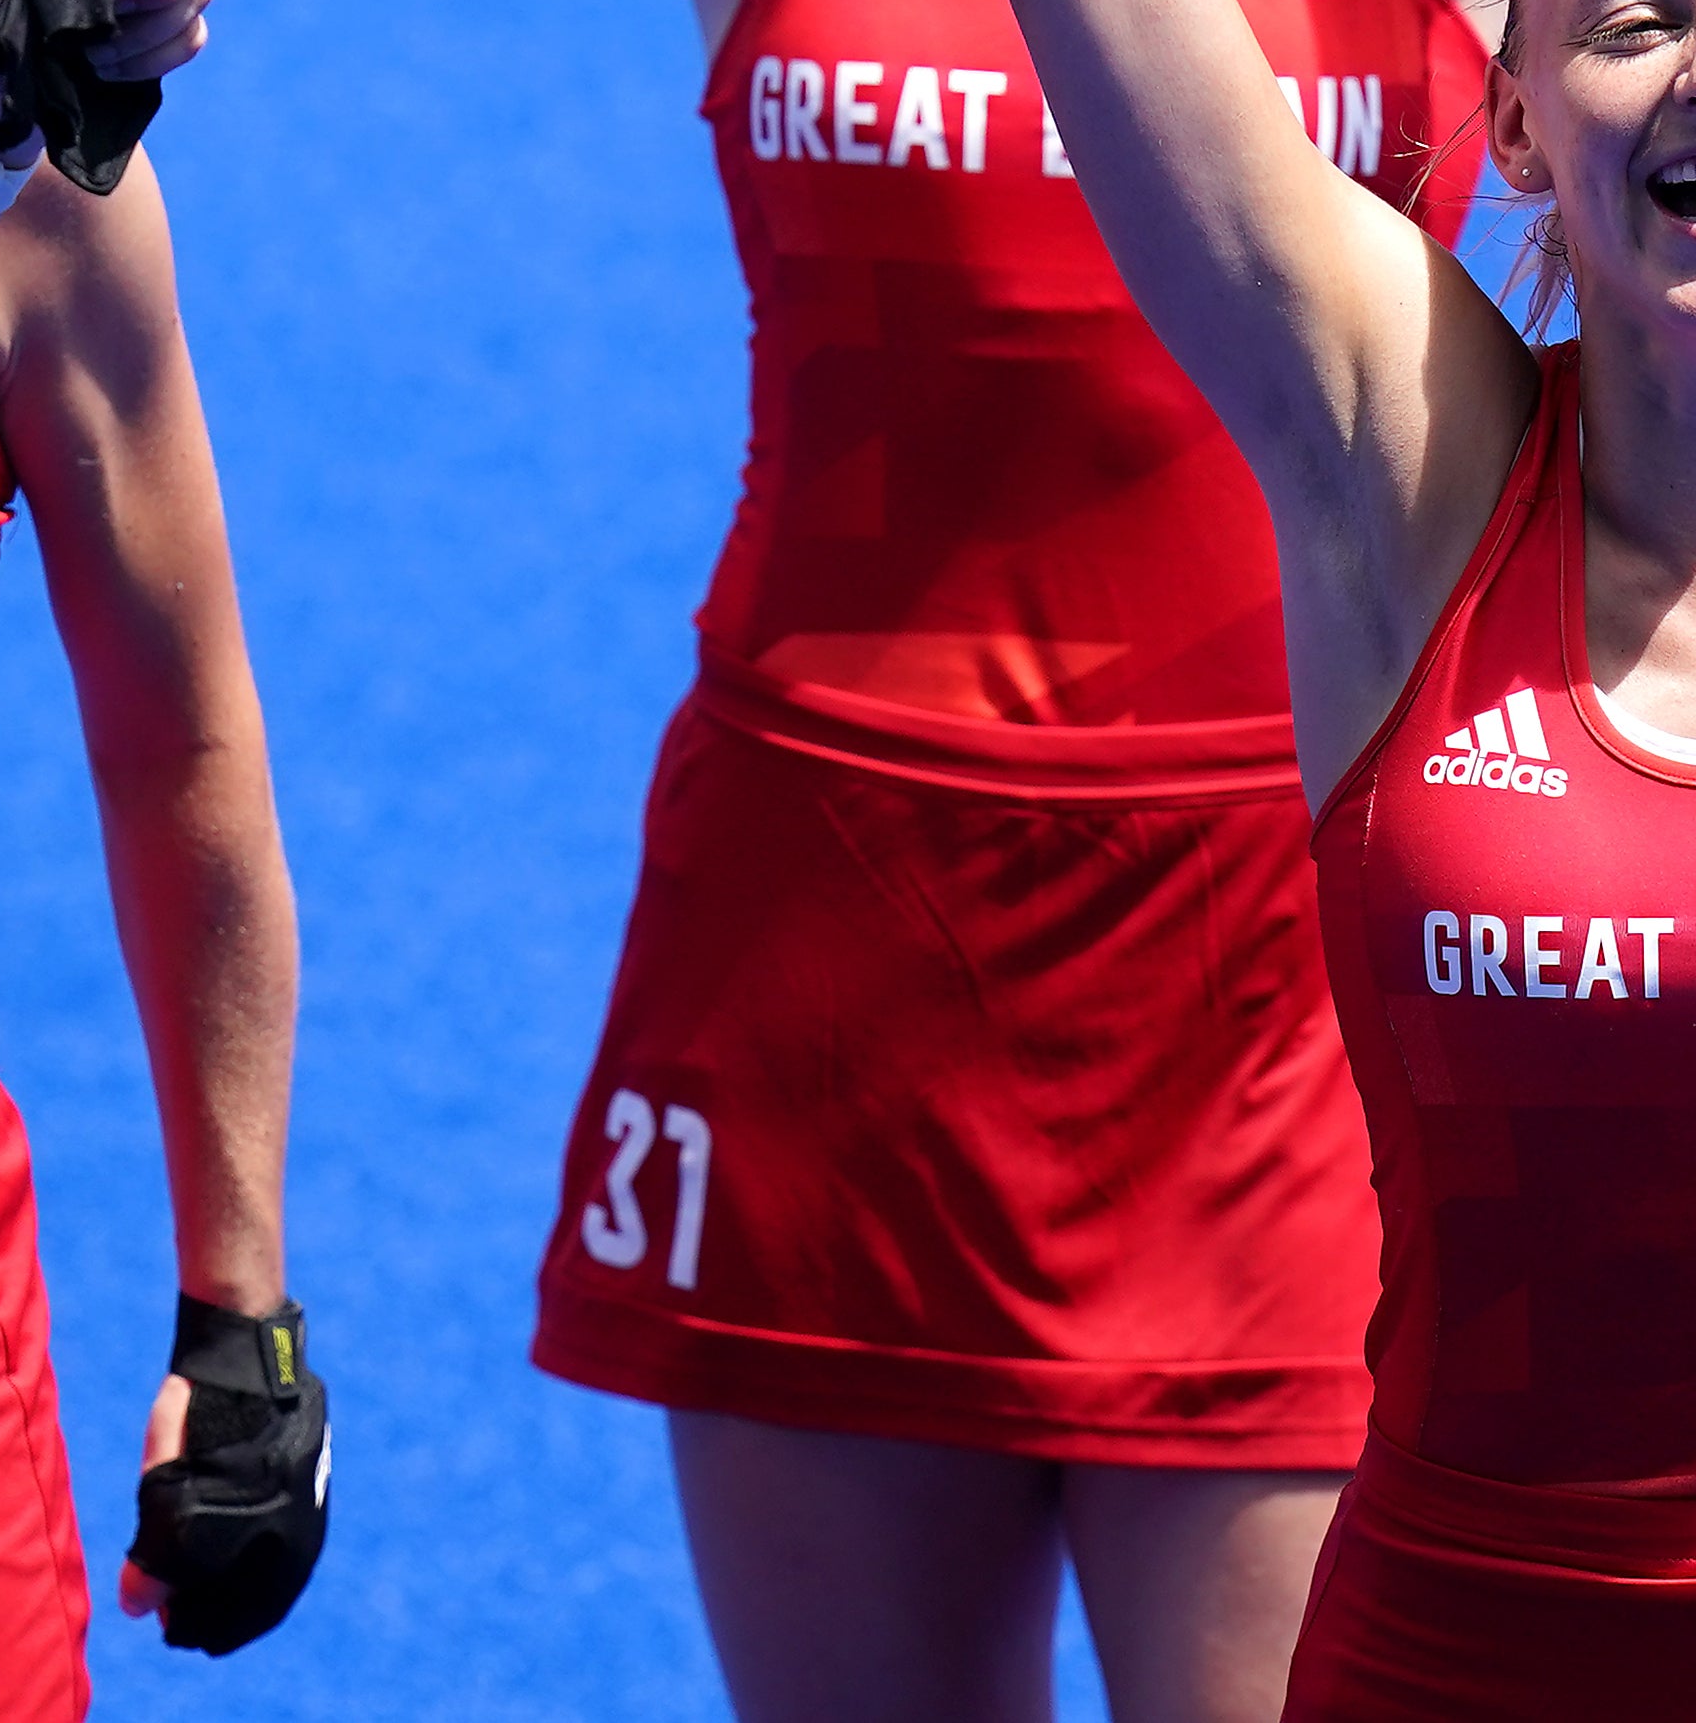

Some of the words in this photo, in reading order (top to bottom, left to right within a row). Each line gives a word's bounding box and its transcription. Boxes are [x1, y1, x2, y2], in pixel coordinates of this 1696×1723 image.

[749, 54, 1008, 174] GREAT
[1422, 748, 1568, 799] adidas
[1423, 908, 1676, 1000] GREAT
